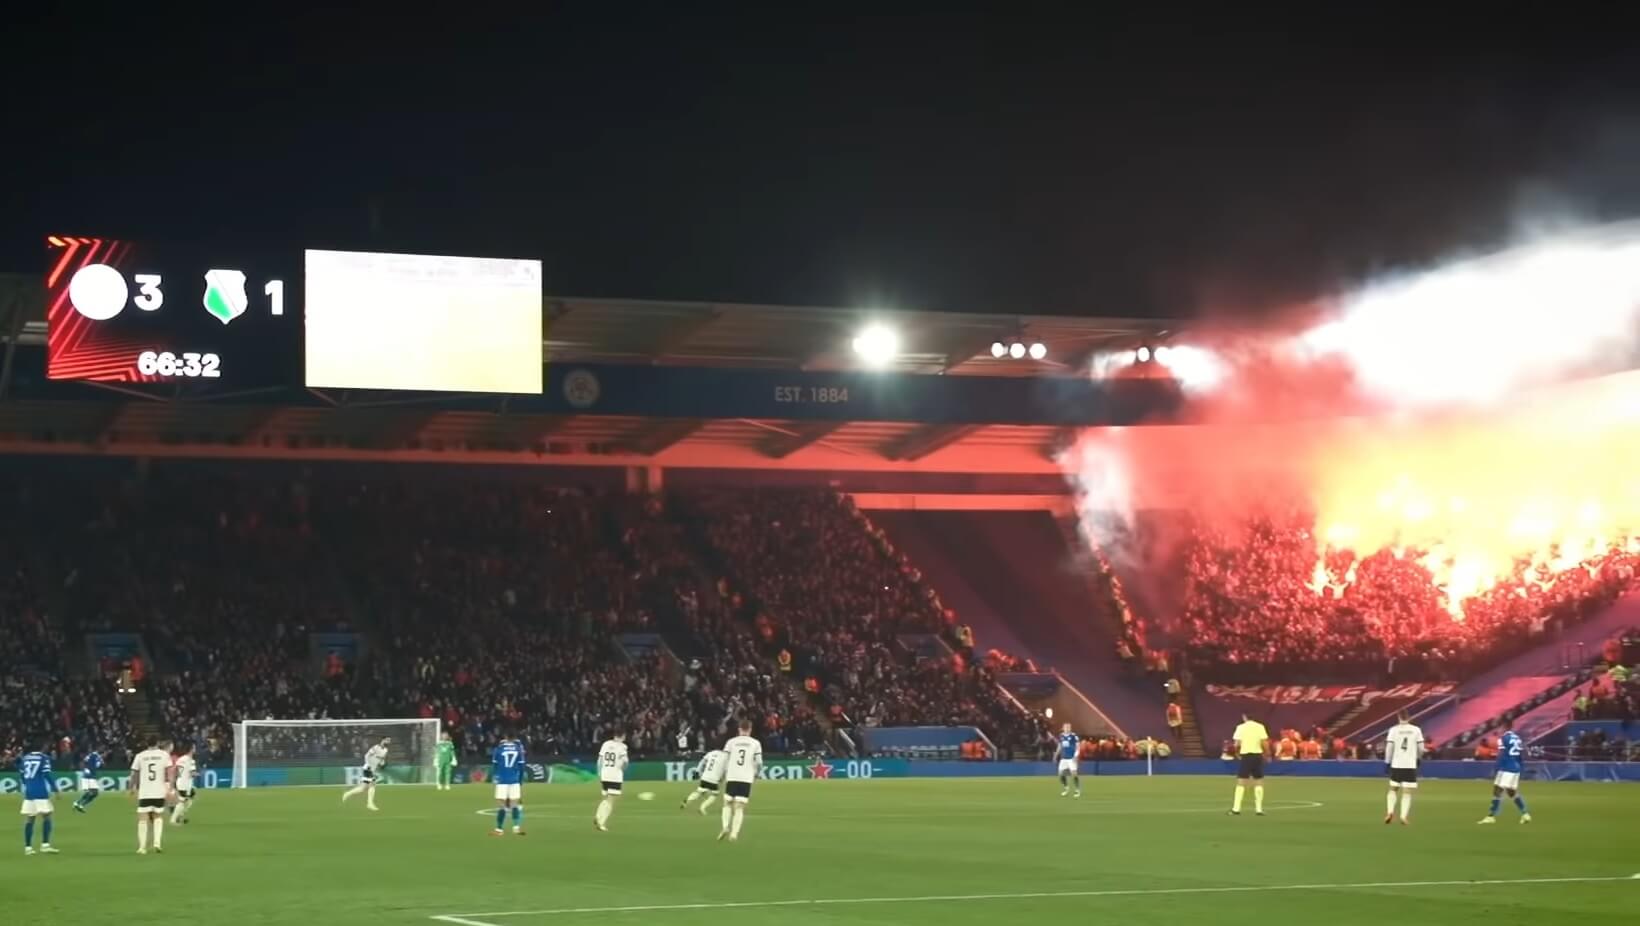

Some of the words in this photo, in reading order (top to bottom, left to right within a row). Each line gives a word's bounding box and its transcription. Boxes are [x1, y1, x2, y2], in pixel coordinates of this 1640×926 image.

[134, 274, 163, 311] 3
[264, 280, 283, 315] 1
[138, 351, 220, 377] 66:32
[776, 386, 804, 402] EST.
[810, 387, 848, 402] 1884
[1401, 736, 1408, 751] 4
[501, 751, 518, 768] 17
[604, 751, 616, 767] 99
[736, 749, 746, 766] 3
[24, 761, 41, 779] 37
[148, 763, 156, 781] 5
